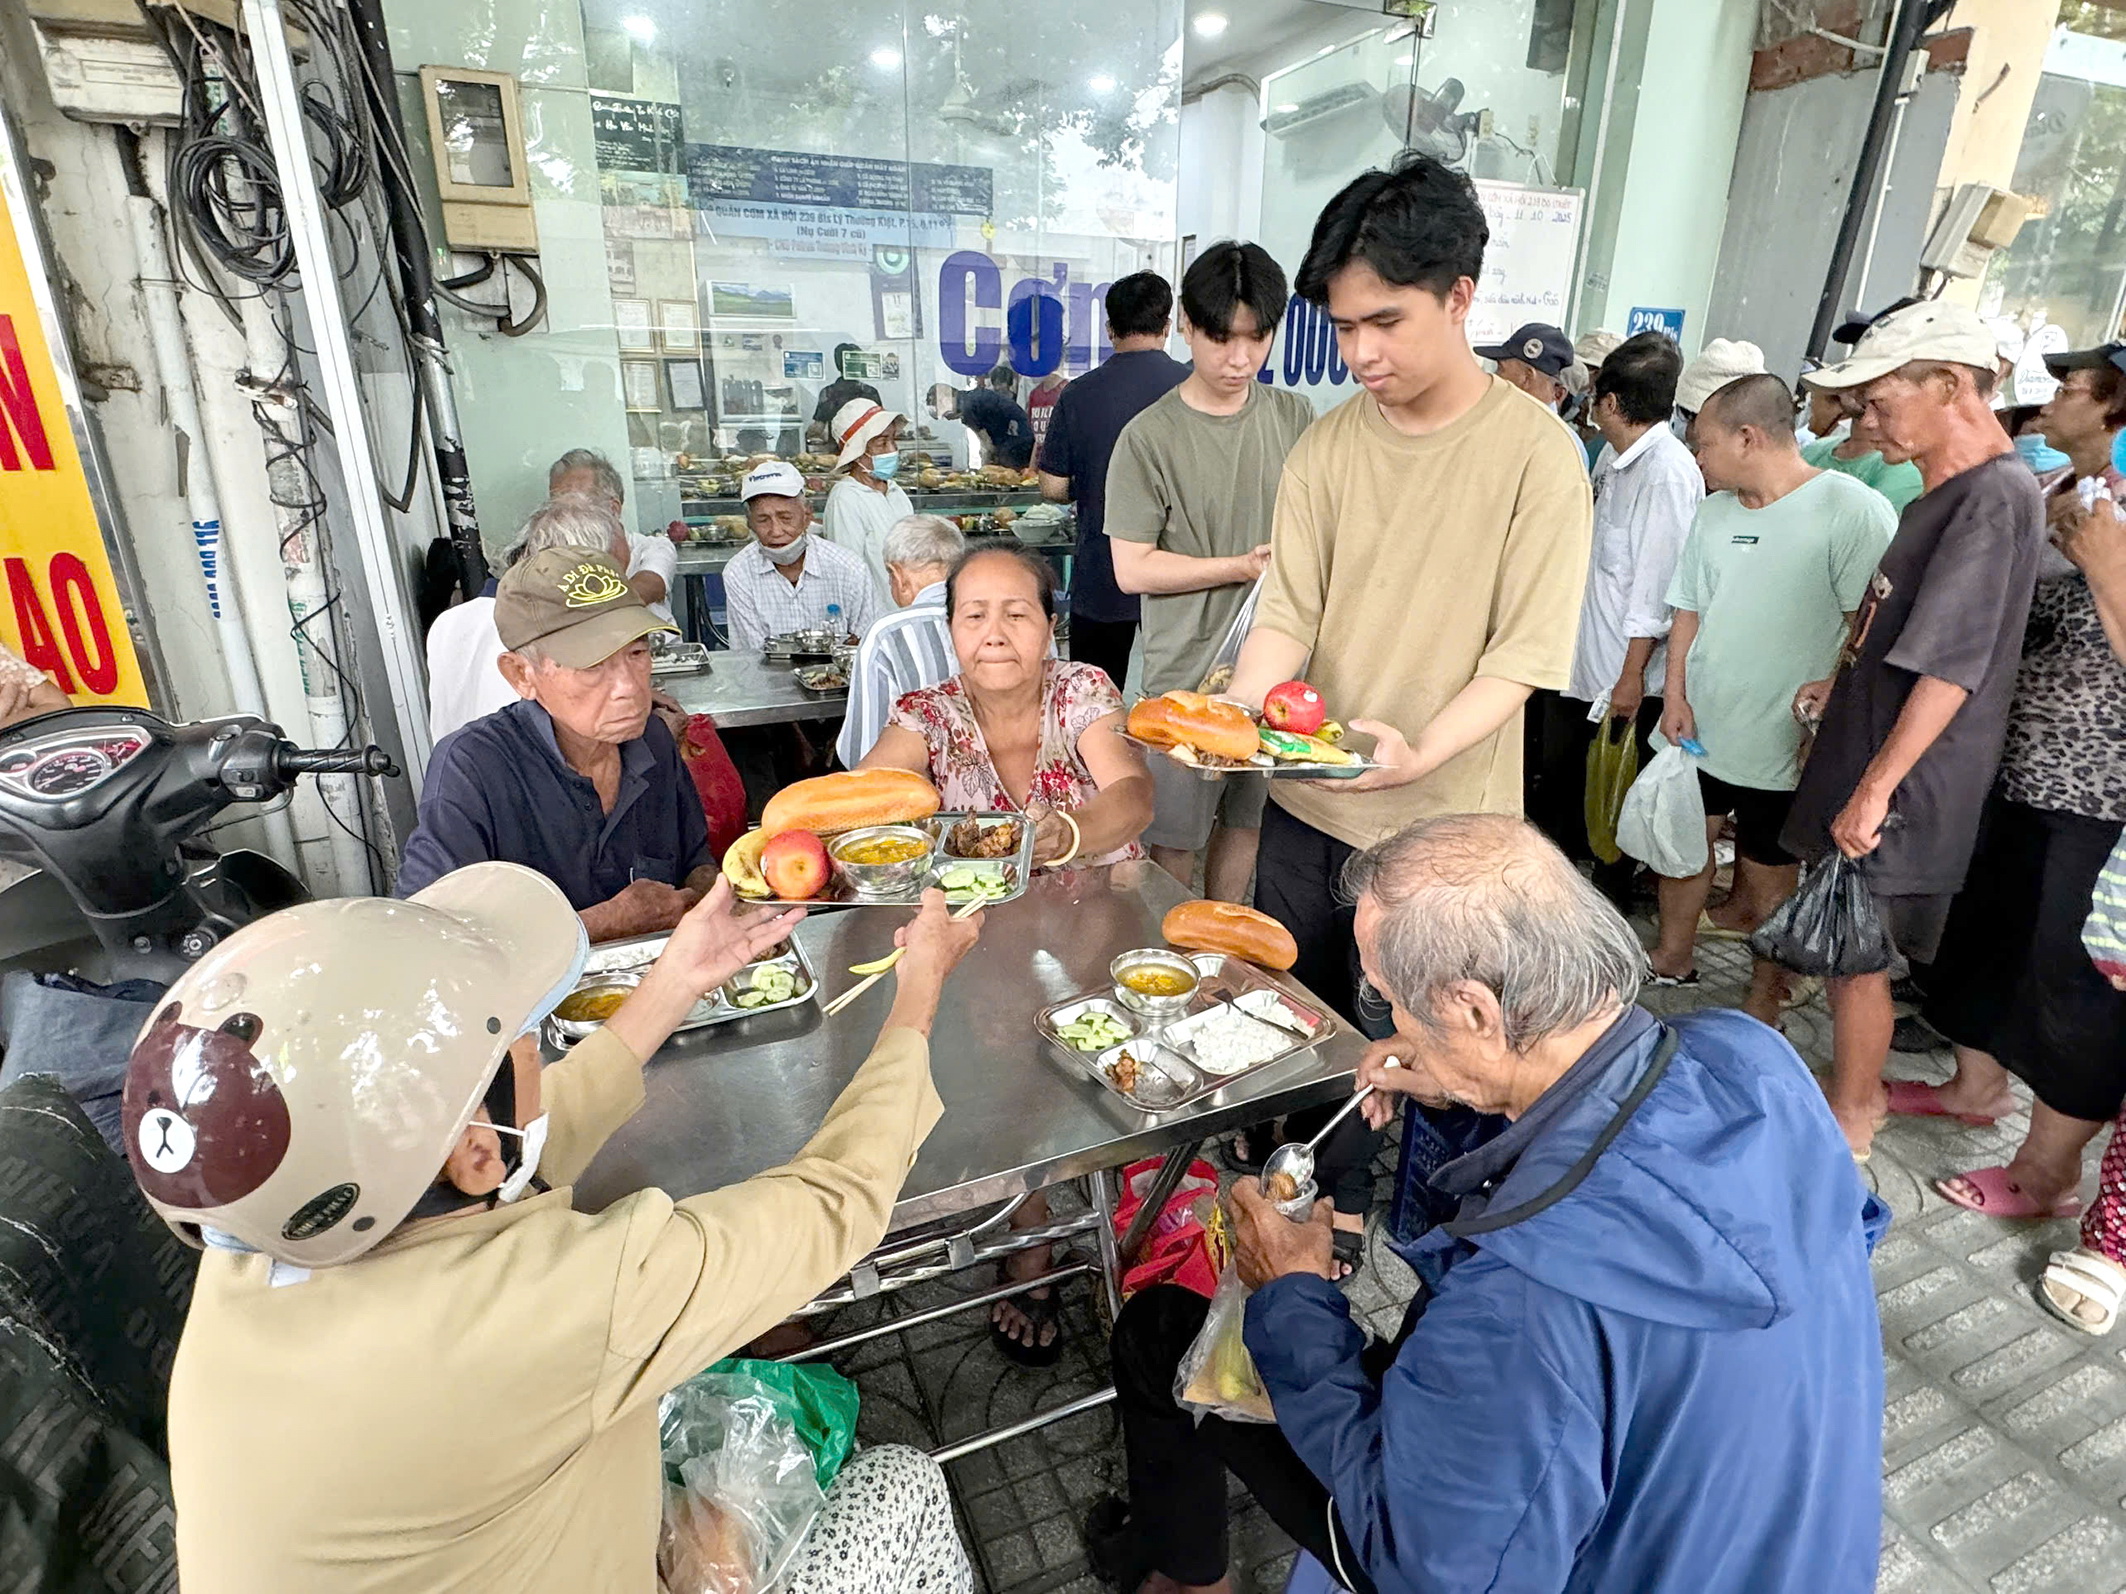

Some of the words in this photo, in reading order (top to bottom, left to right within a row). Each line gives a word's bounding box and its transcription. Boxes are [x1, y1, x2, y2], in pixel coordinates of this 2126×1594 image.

[743, 208, 765, 219] CƠM
[799, 212, 815, 222] 239
[841, 228, 848, 238] 7
